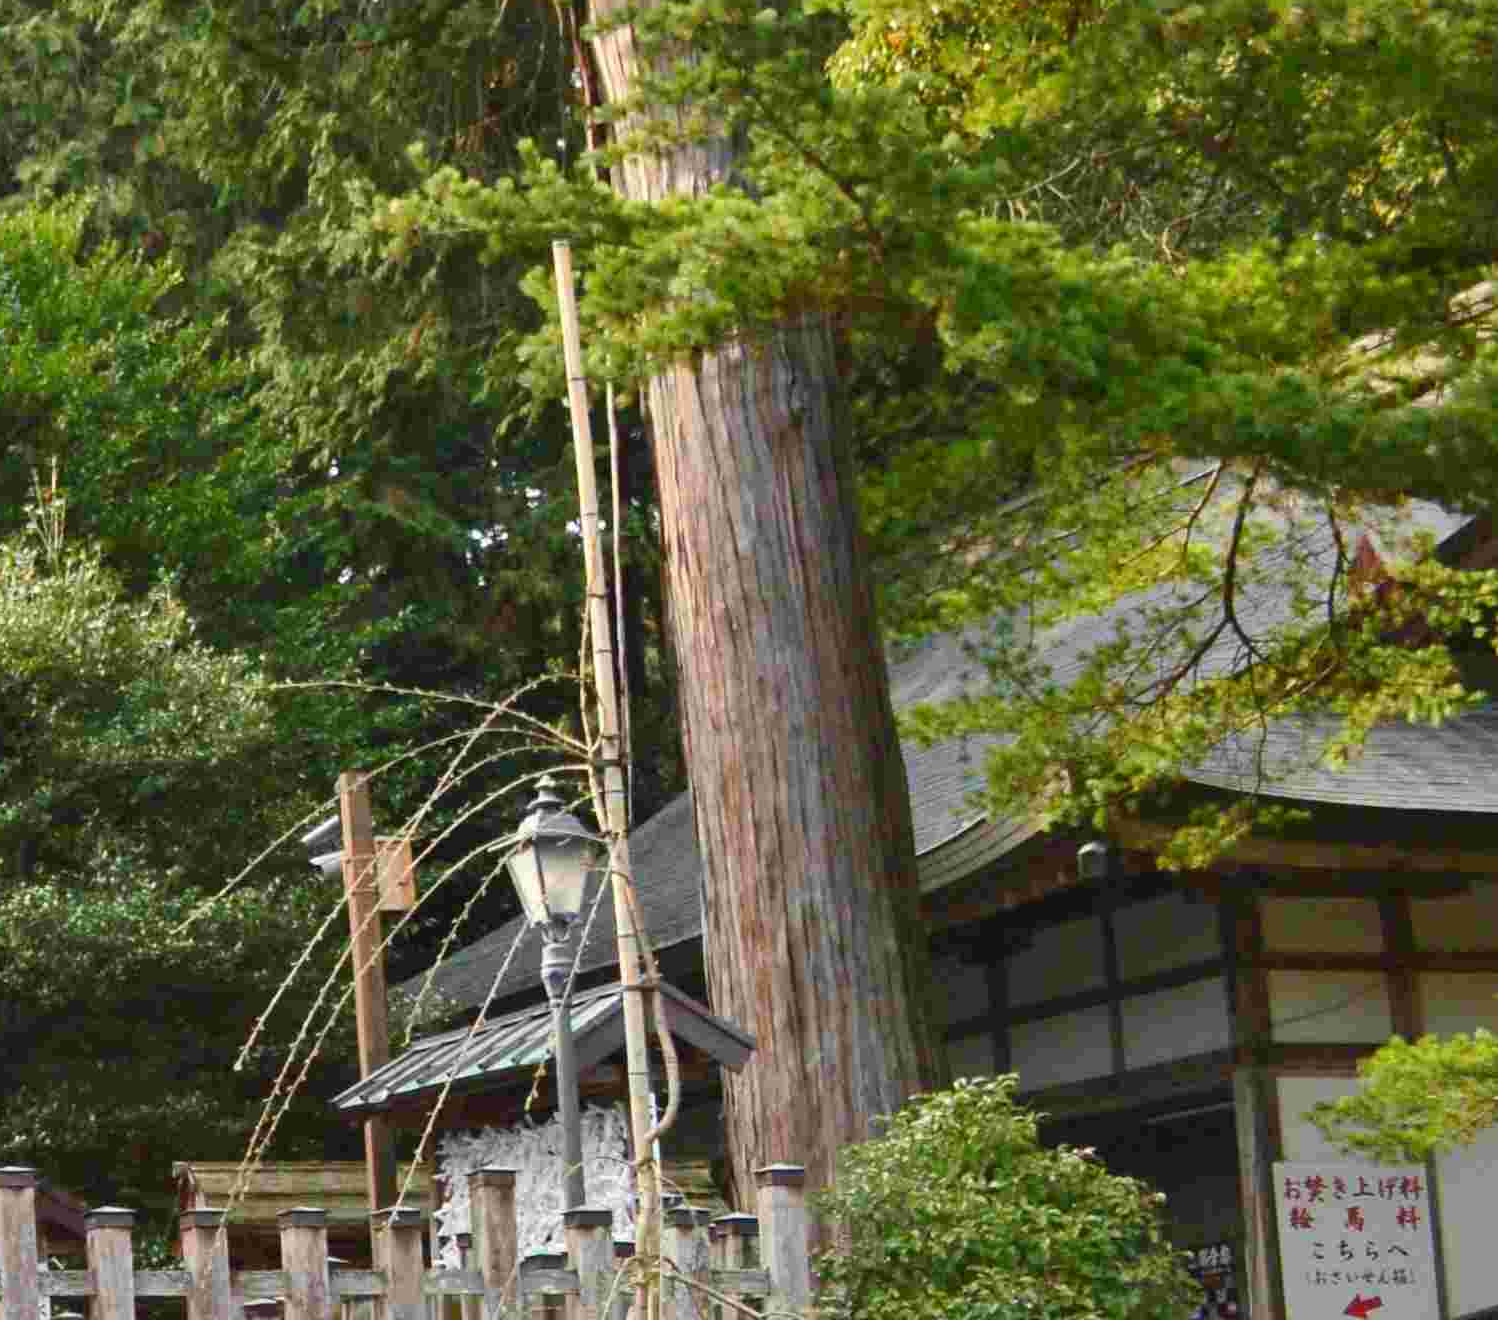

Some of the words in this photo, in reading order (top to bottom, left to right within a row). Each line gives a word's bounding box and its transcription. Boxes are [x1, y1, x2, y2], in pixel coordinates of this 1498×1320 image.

[1284, 1174, 1424, 1203] お焚き上げ料
[1312, 1240, 1410, 1261] こちらへ
